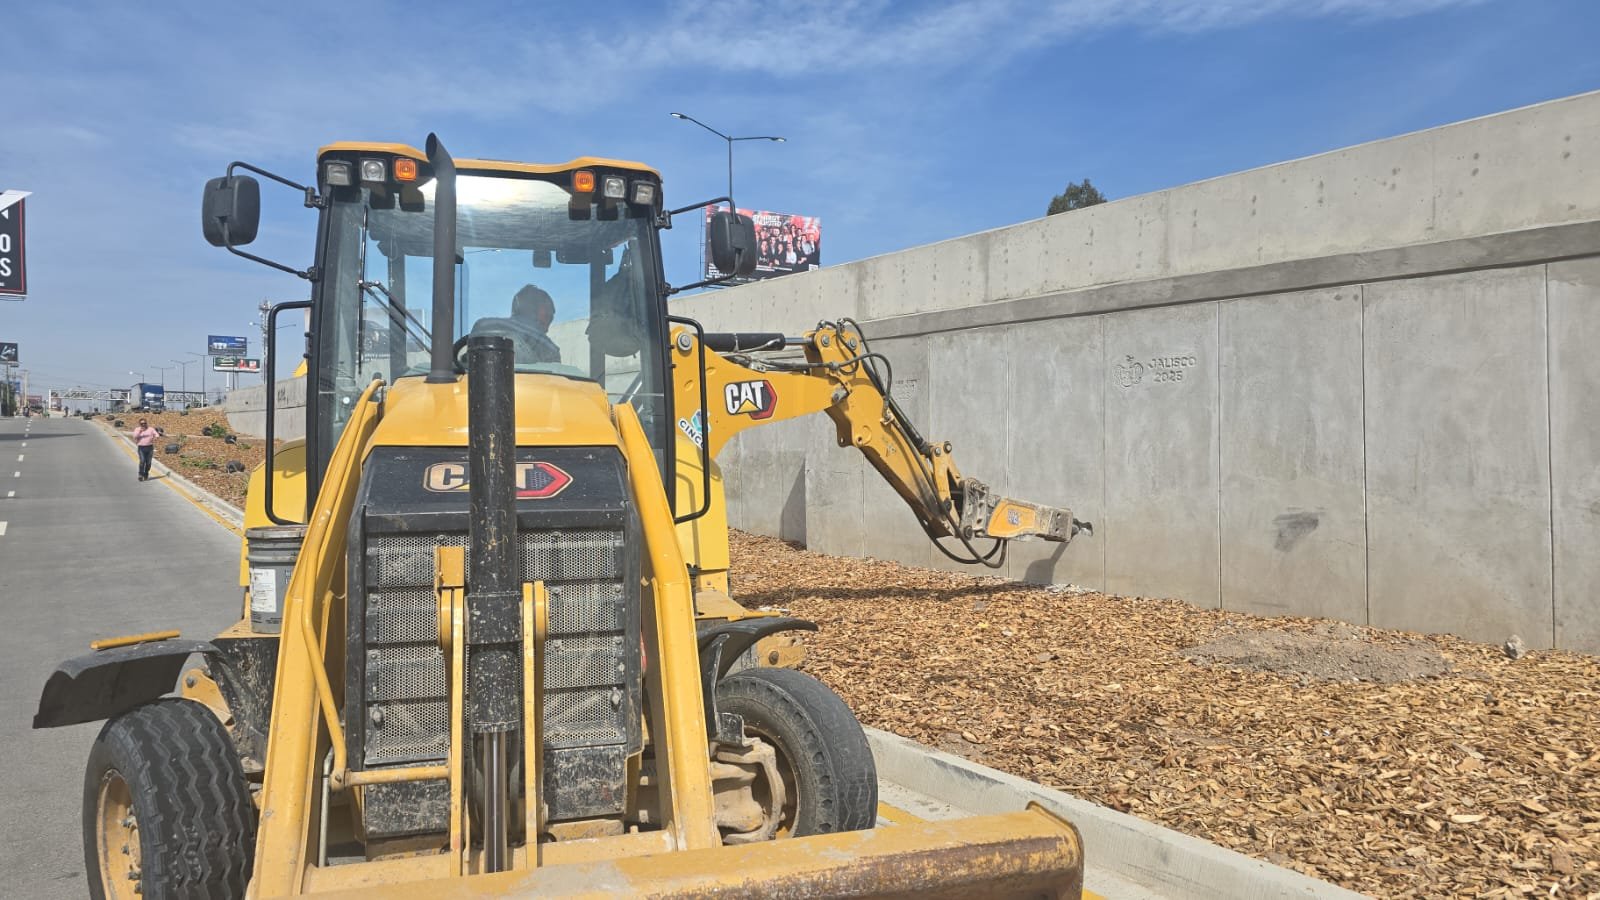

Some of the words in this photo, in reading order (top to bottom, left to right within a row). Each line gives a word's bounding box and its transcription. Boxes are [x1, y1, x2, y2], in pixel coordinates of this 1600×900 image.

[1147, 356, 1197, 368] JALISCO
[1154, 370, 1183, 382] 2025
[725, 381, 763, 414] CAT
[679, 420, 703, 447] CINC
[430, 463, 534, 490] CT
